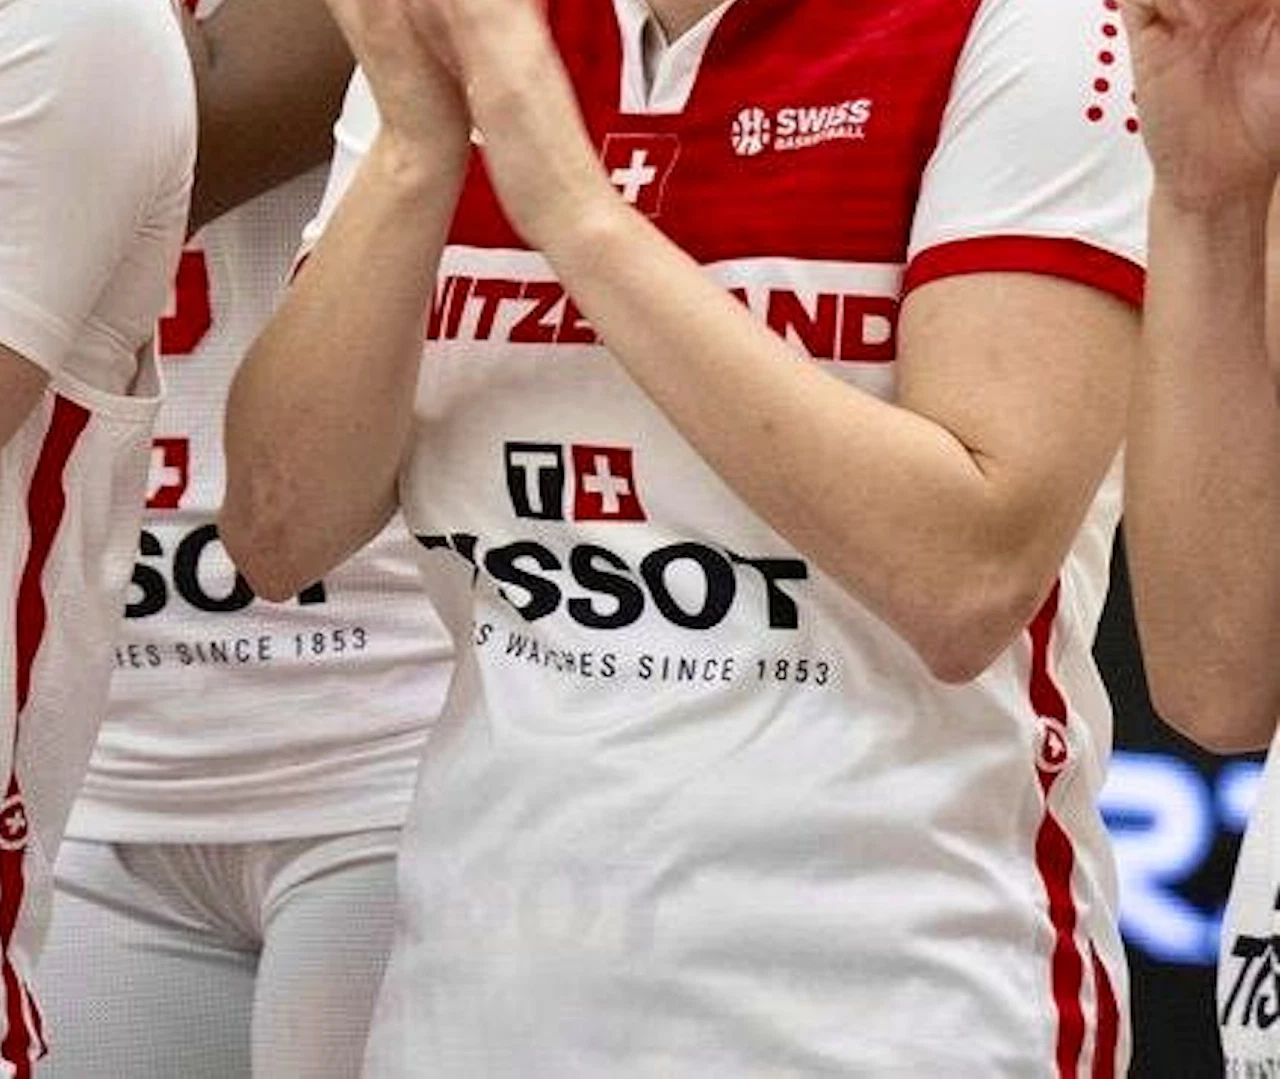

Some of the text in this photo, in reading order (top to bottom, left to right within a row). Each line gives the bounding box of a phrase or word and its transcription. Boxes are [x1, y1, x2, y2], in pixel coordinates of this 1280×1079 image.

[776, 98, 872, 135] SWISS
[175, 636, 273, 666] SINCE
[295, 627, 366, 658] 1853
[640, 653, 734, 682] SINCE
[757, 659, 829, 686] 1853
